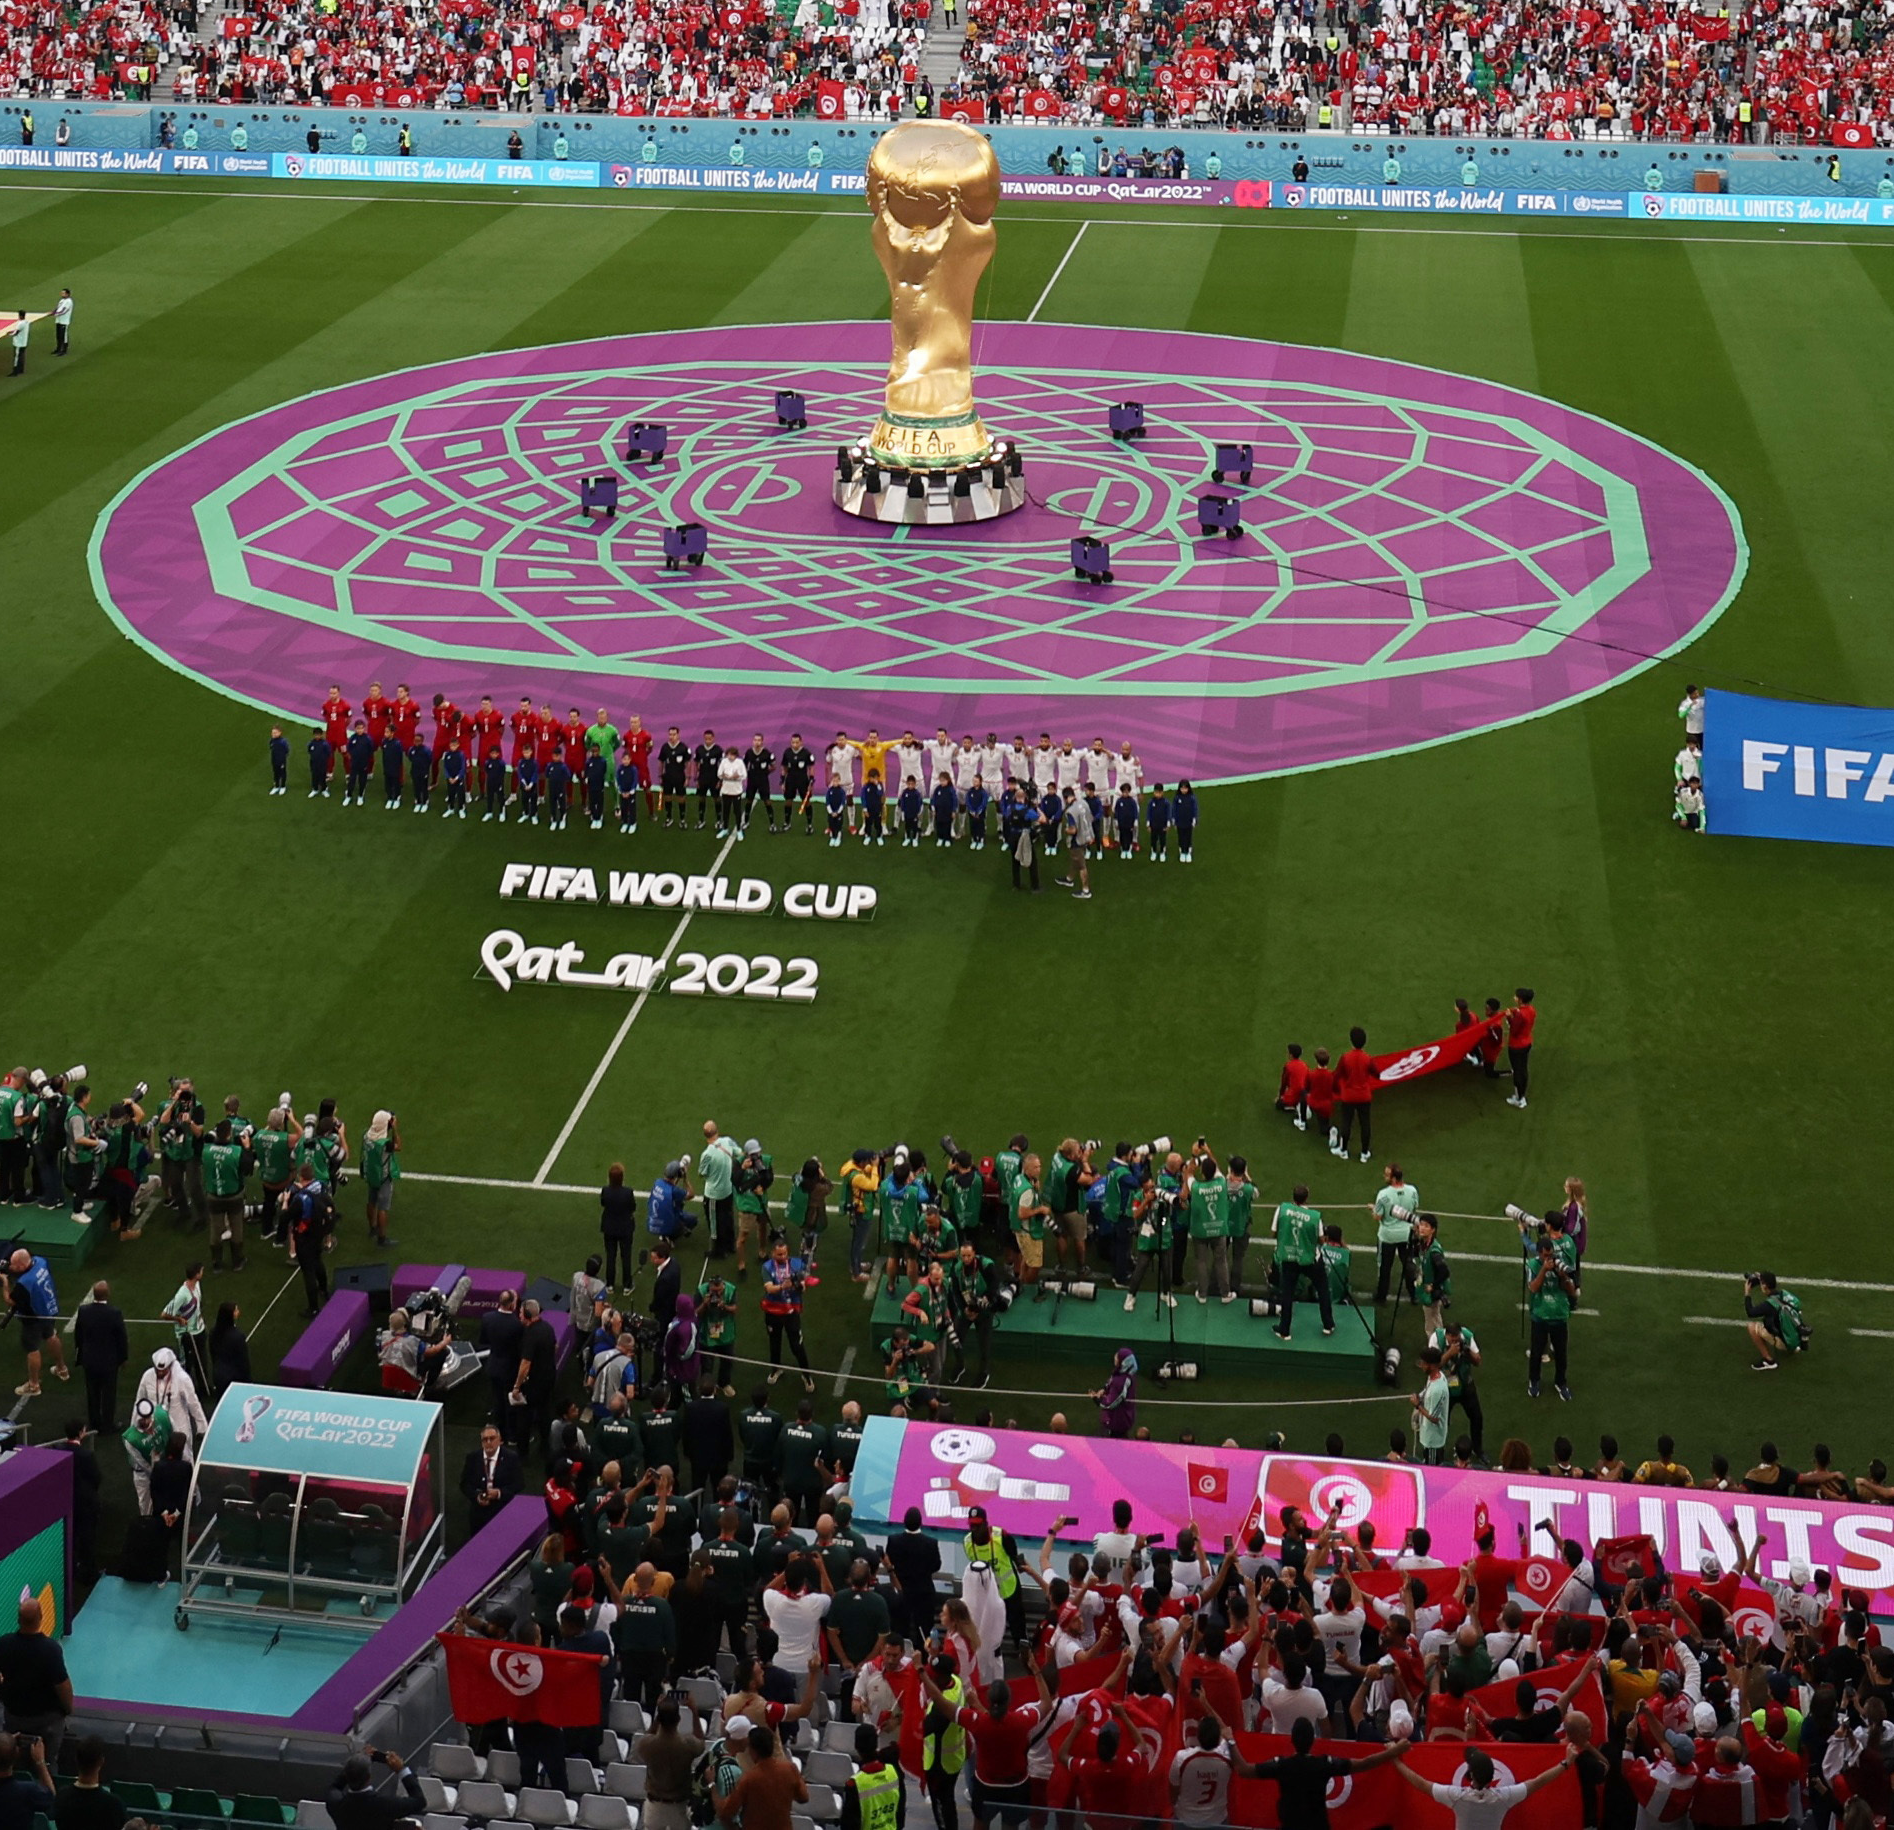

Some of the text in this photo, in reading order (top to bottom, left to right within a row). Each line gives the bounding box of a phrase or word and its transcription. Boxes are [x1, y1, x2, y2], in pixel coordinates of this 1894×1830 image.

[55, 151, 97, 168] UNITES
[99, 152, 123, 170] the
[123, 152, 162, 172] World
[174, 156, 209, 170] FIFA
[636, 168, 819, 191] FOOTBALL UNITES the World
[831, 175, 867, 190] FIFA
[1025, 184, 1073, 196] WORLD
[1075, 185, 1100, 197] CUP
[1310, 188, 1505, 213] FOOTBALL UNITES the World
[1517, 195, 1557, 211] FIFA
[888, 427, 941, 442] FIFA
[927, 442, 955, 454] CUP
[499, 864, 878, 918] FIFA WORLD CUP
[481, 929, 819, 999] Qatar 2022
[1198, 1185, 1223, 1195] PHOTO
[1286, 1209, 1311, 1222] PHOTO
[275, 1408, 413, 1432] FIFA WORLD CUP
[1197, 1780, 1217, 1805] 3
